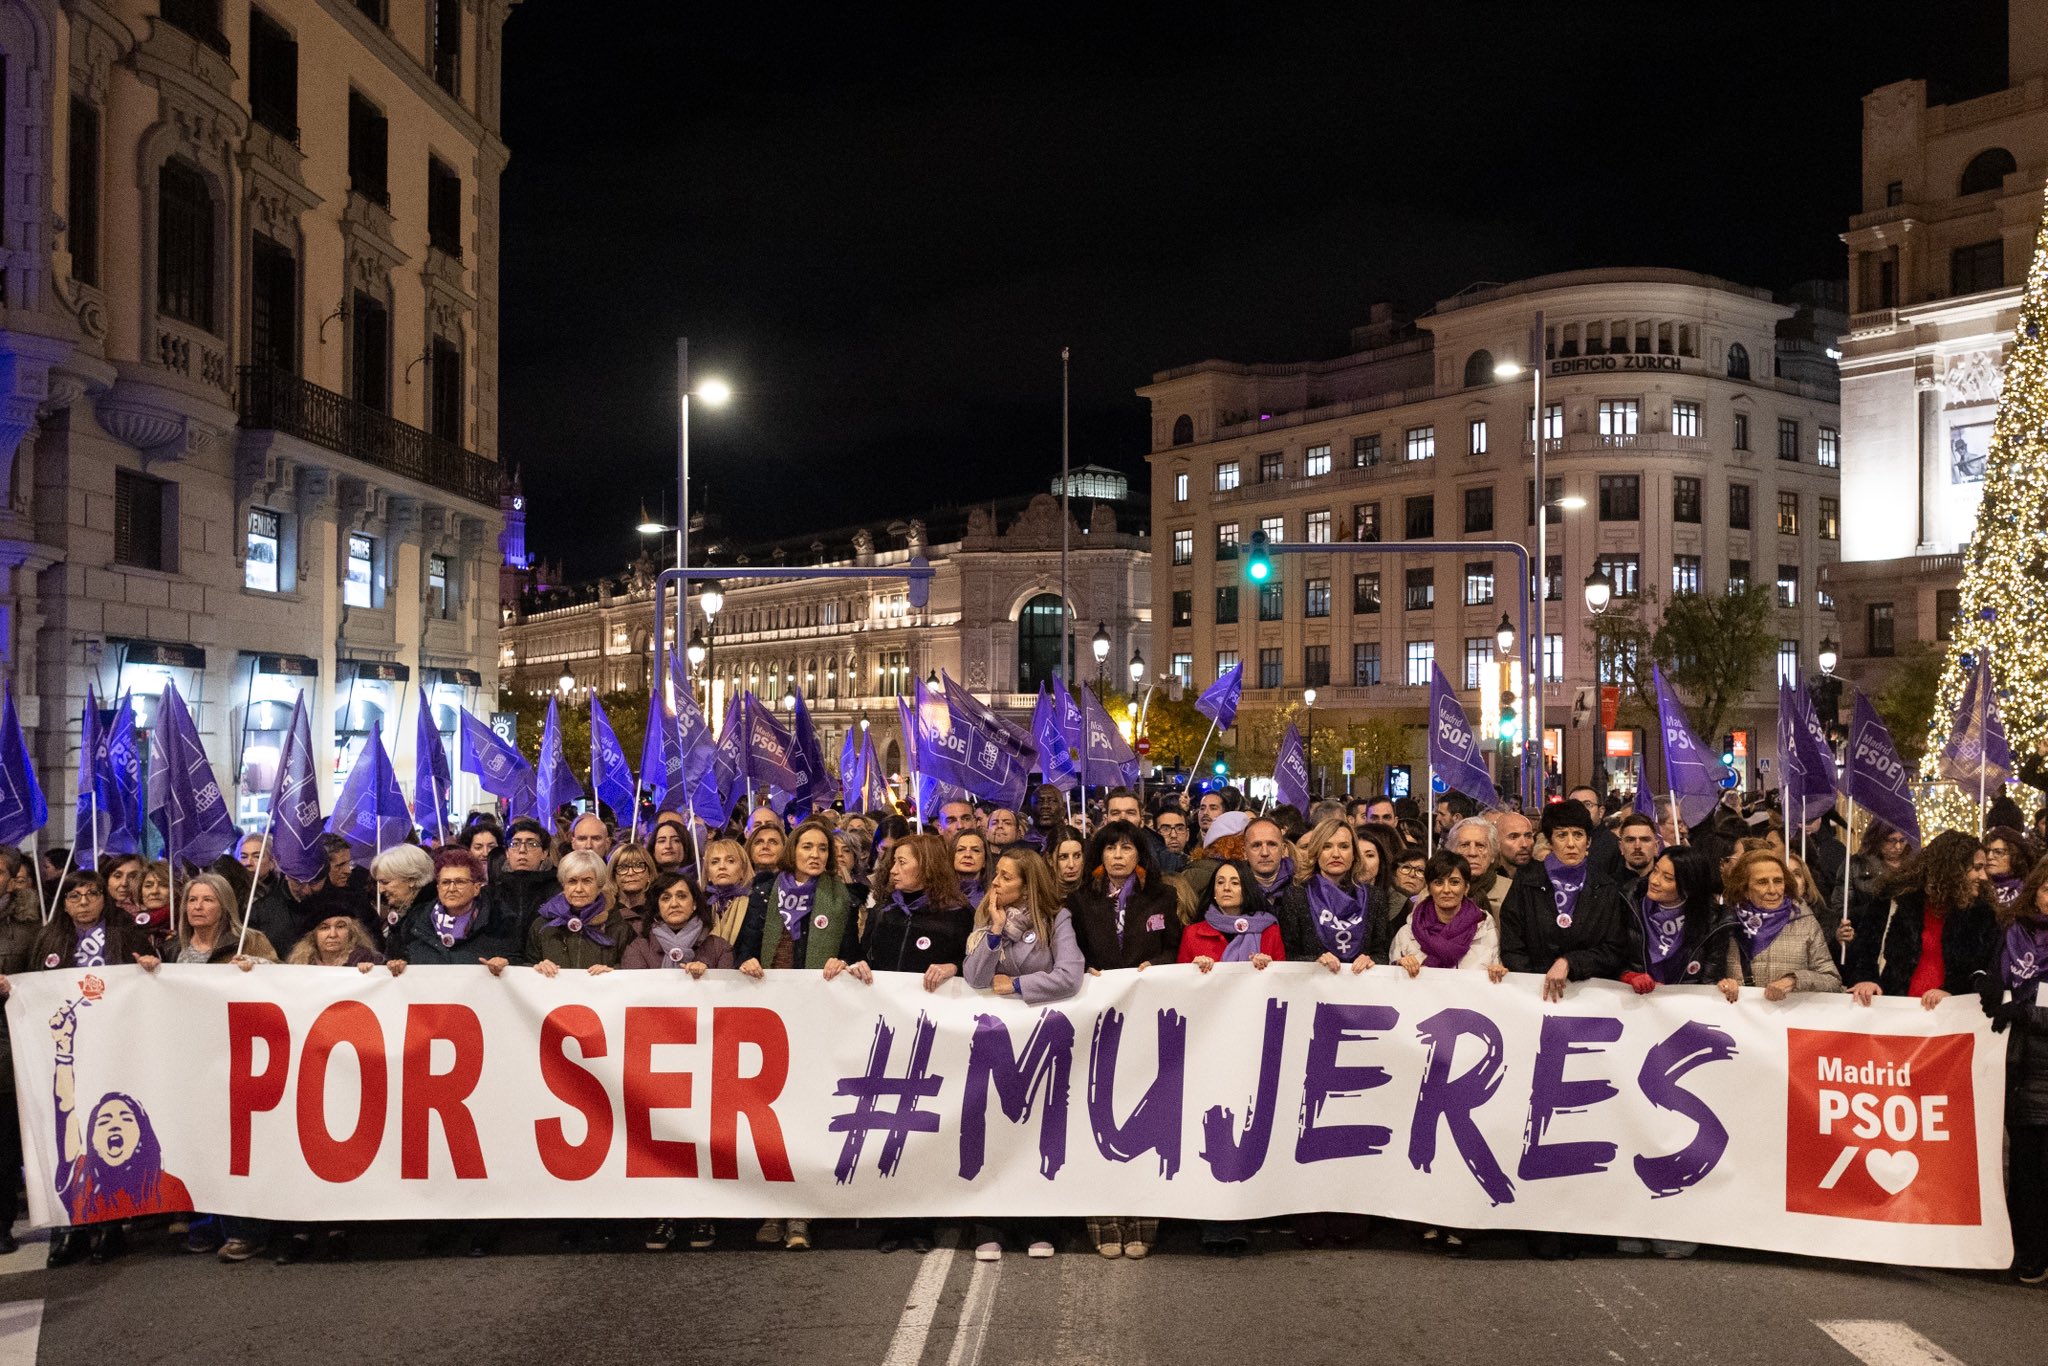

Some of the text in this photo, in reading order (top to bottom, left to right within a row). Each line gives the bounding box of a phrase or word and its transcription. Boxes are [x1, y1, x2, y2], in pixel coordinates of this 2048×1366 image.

[1552, 356, 1681, 374] EDIFICIO ZURICH
[752, 733, 786, 757] PSOE
[754, 725, 777, 742] Madrid
[930, 727, 967, 754] PSOE
[1862, 733, 1893, 756] Madrid
[602, 745, 620, 767] OE
[1287, 755, 1308, 781] PSOE
[1855, 743, 1901, 780] PSOE
[1817, 1056, 1911, 1087] Madrid
[227, 997, 1740, 1208] POR SER #MUJERES
[1818, 1089, 1950, 1142] PSOE
